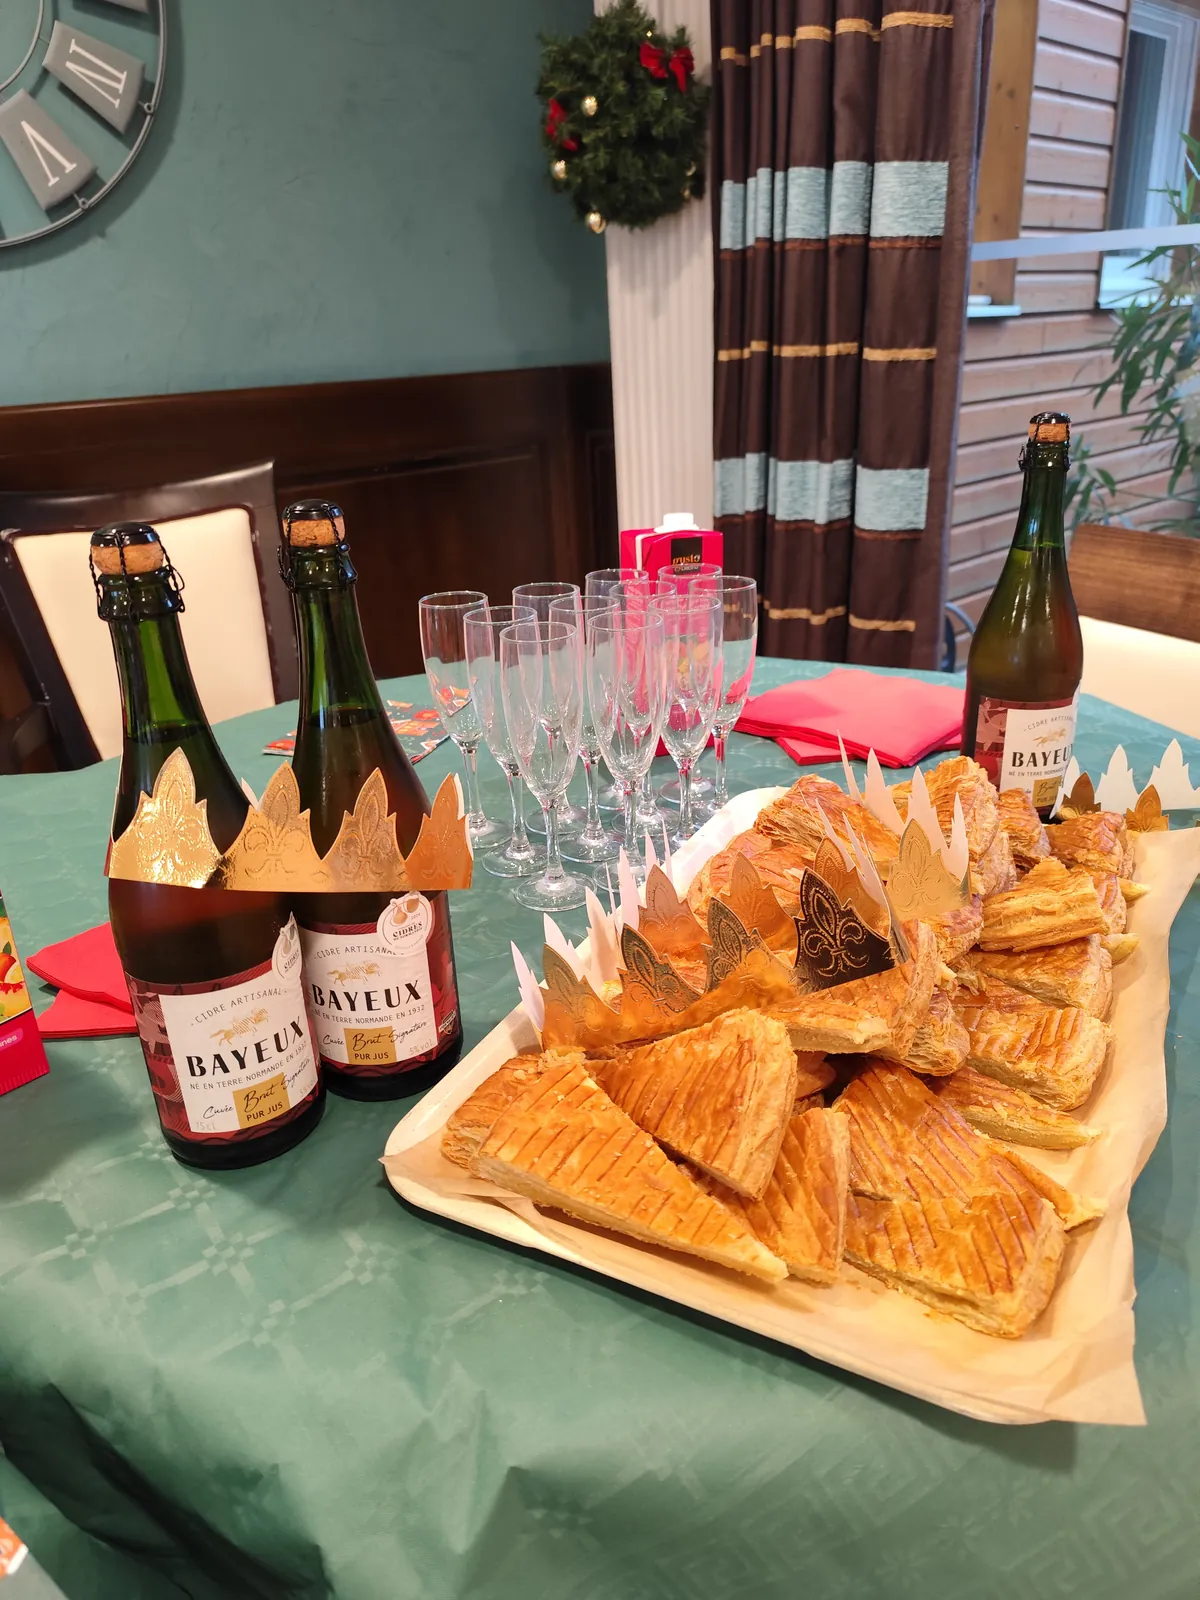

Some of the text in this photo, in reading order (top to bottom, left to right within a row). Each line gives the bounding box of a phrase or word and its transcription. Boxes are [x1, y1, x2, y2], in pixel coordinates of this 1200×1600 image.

[21, 120, 77, 187] V
[1027, 719, 1048, 731] CIDRE
[392, 921, 423, 938] CIDRES
[316, 947, 341, 959] CIDRE
[194, 987, 283, 1024] CIDRE ARTISANAL
[311, 979, 422, 1012] BAYEUX
[322, 1012, 330, 1020] EN
[331, 1015, 353, 1024] TERRE
[355, 1014, 393, 1024] NORMANDE
[396, 1011, 406, 1020] EN
[408, 1004, 425, 1016] 1932
[186, 1016, 304, 1078] BAYEUX
[352, 1032, 388, 1051] Brut
[373, 1051, 389, 1060] JUS
[203, 1082, 214, 1090] EN
[217, 1077, 244, 1089] TERRE
[246, 1059, 284, 1082] NORMANDE
[285, 1052, 294, 1063] EN
[203, 1104, 234, 1119] Cuvée
[243, 1081, 281, 1114] Brut
[246, 1101, 284, 1122] PUR JUS
